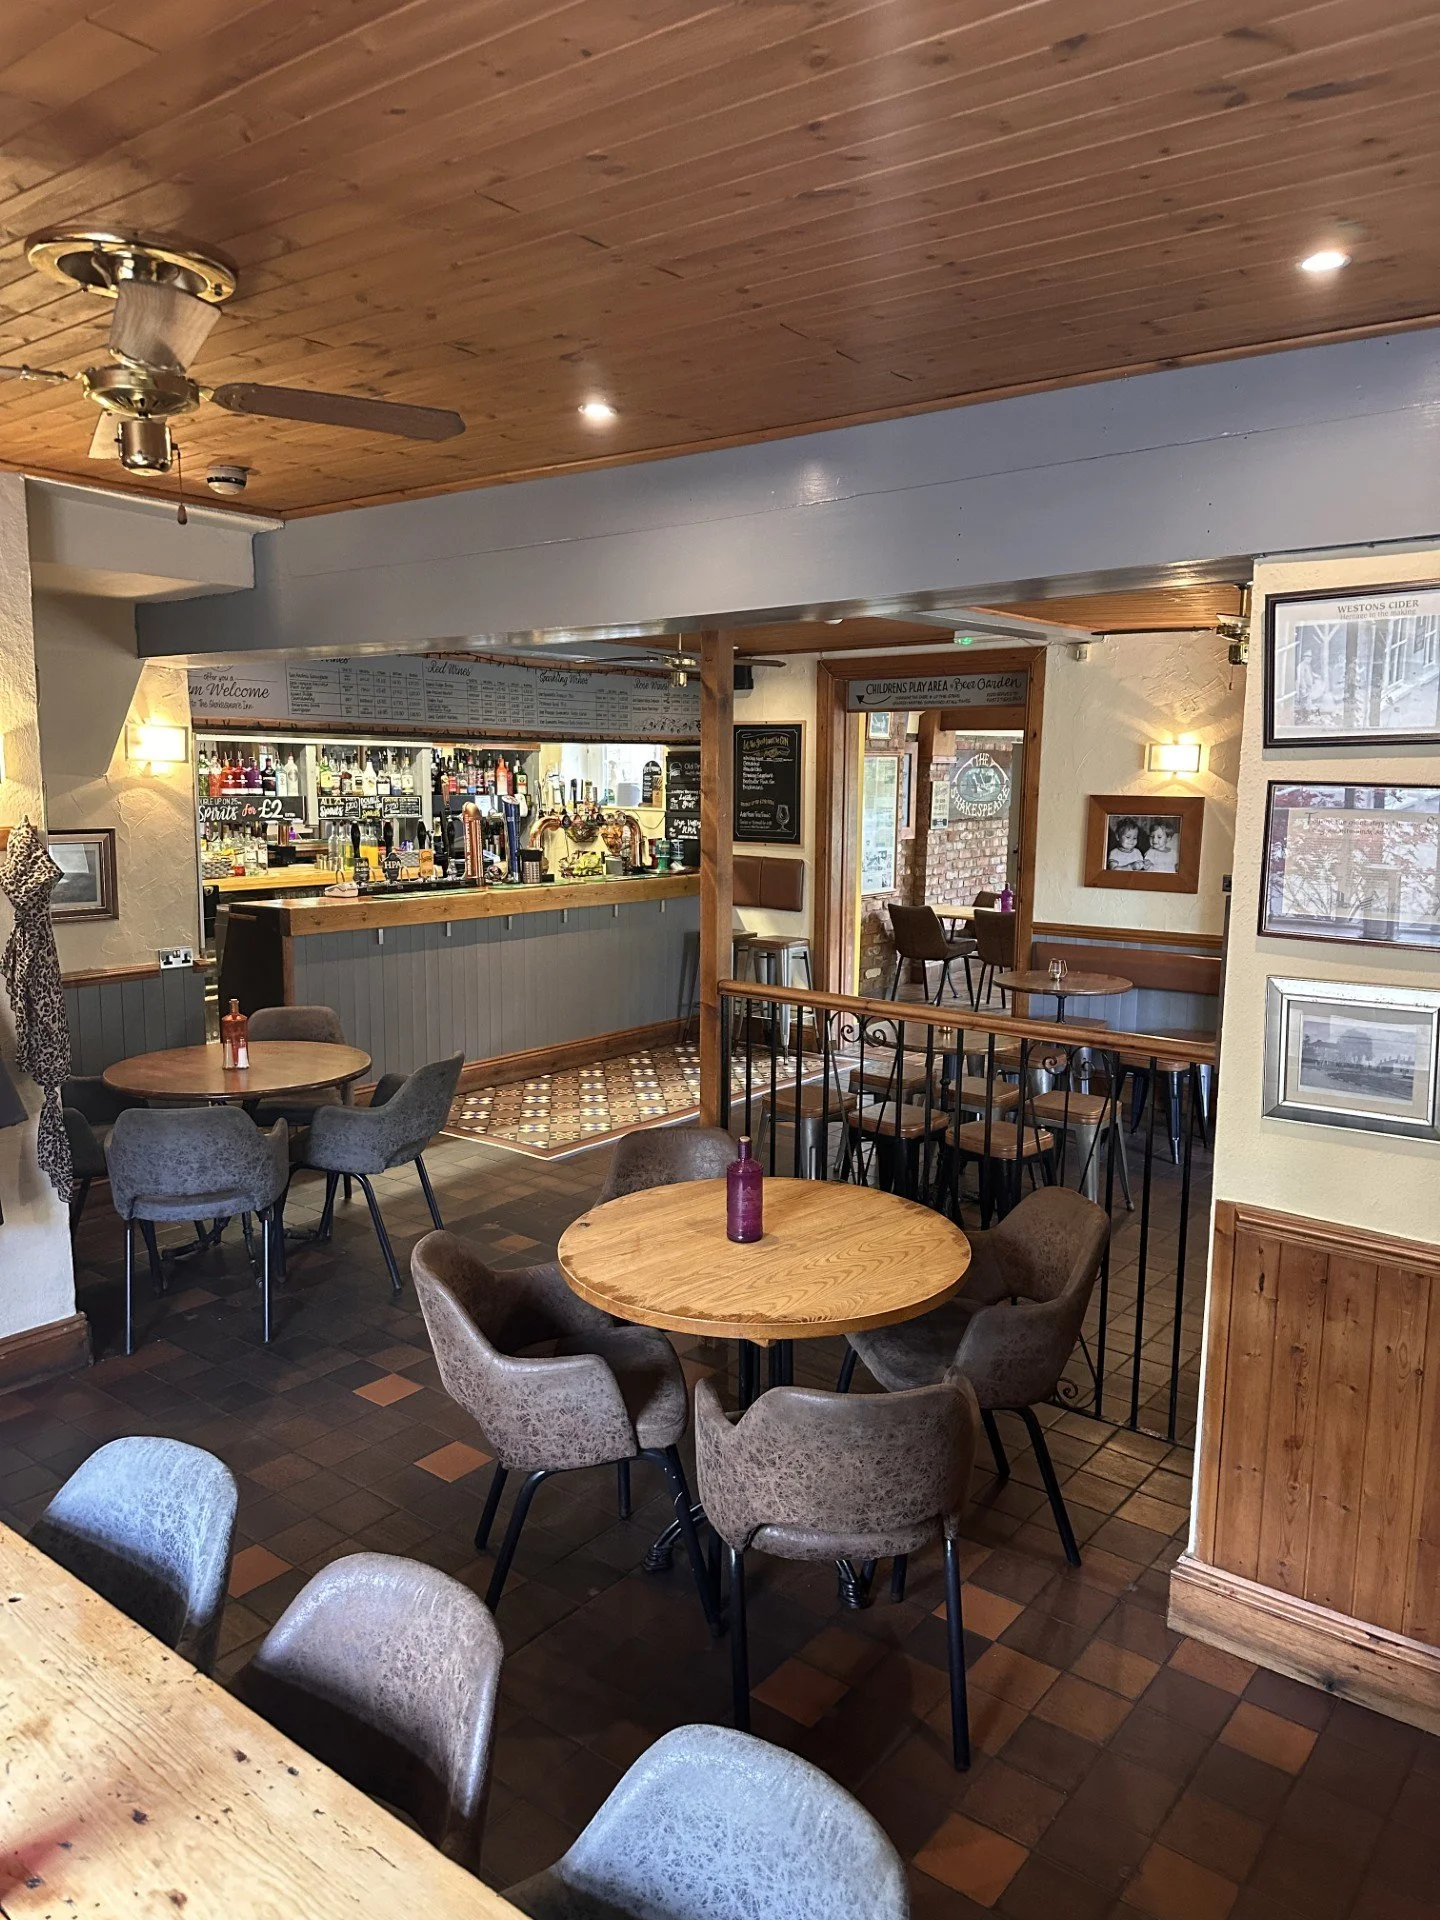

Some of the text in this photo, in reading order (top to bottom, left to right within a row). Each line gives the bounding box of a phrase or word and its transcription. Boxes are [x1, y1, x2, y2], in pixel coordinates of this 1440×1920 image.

[1338, 599, 1420, 614] WESTONS CIDER
[1378, 609, 1389, 617] the
[1391, 607, 1417, 616] making
[428, 660, 471, 677] Red Wines
[206, 681, 271, 699] Welcome
[866, 676, 1022, 696] CHILDRENS PLAY AREA Beer Garden
[975, 753, 991, 767] THE
[214, 797, 221, 806] UP
[222, 797, 231, 806] ON
[951, 785, 1010, 817] SHAKESPEARE
[198, 805, 239, 822] Spirits
[241, 803, 253, 817] for
[257, 798, 284, 819] £2
[384, 860, 401, 869] HPA
